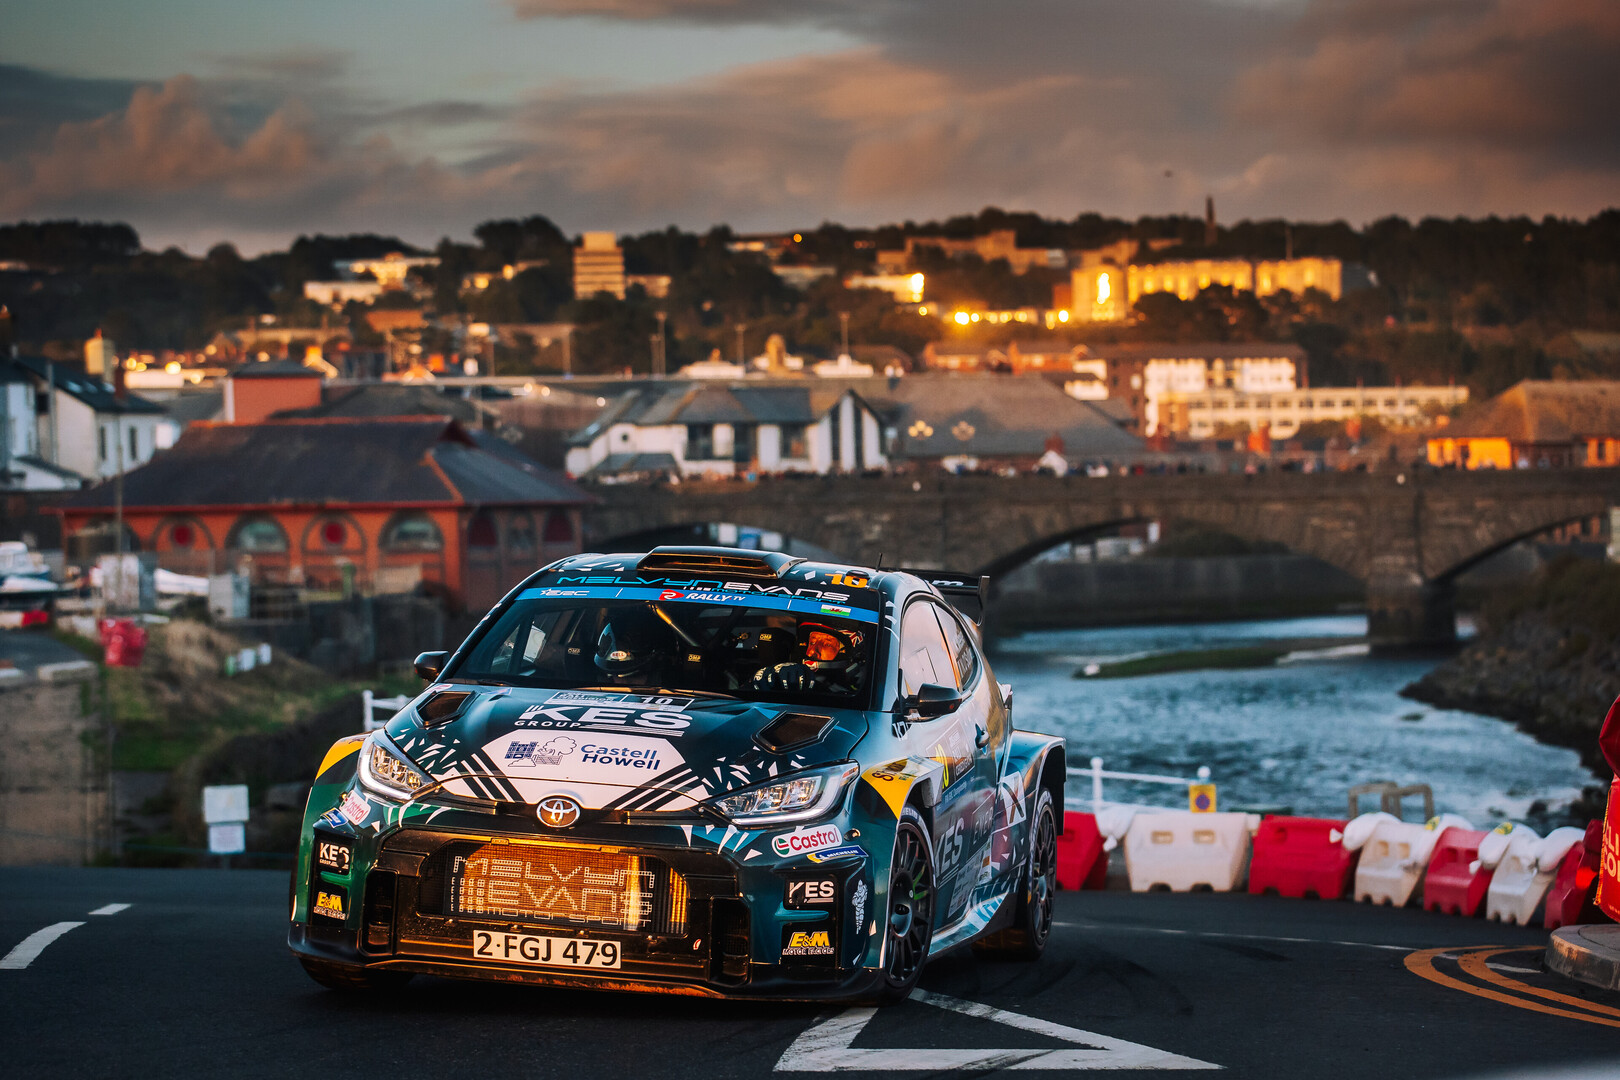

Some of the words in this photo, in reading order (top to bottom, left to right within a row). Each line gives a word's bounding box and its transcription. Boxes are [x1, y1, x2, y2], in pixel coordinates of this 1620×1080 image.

[825, 573, 869, 588] 10
[723, 581, 850, 601] EVANS
[641, 696, 674, 705] 10
[514, 720, 581, 728] GROUP
[519, 705, 693, 729] KES
[580, 744, 657, 760] Castell
[582, 753, 660, 770] Howell
[790, 828, 840, 851] Castrol
[320, 842, 350, 864] KES
[316, 891, 343, 912] E&M
[789, 931, 830, 947] E&M
